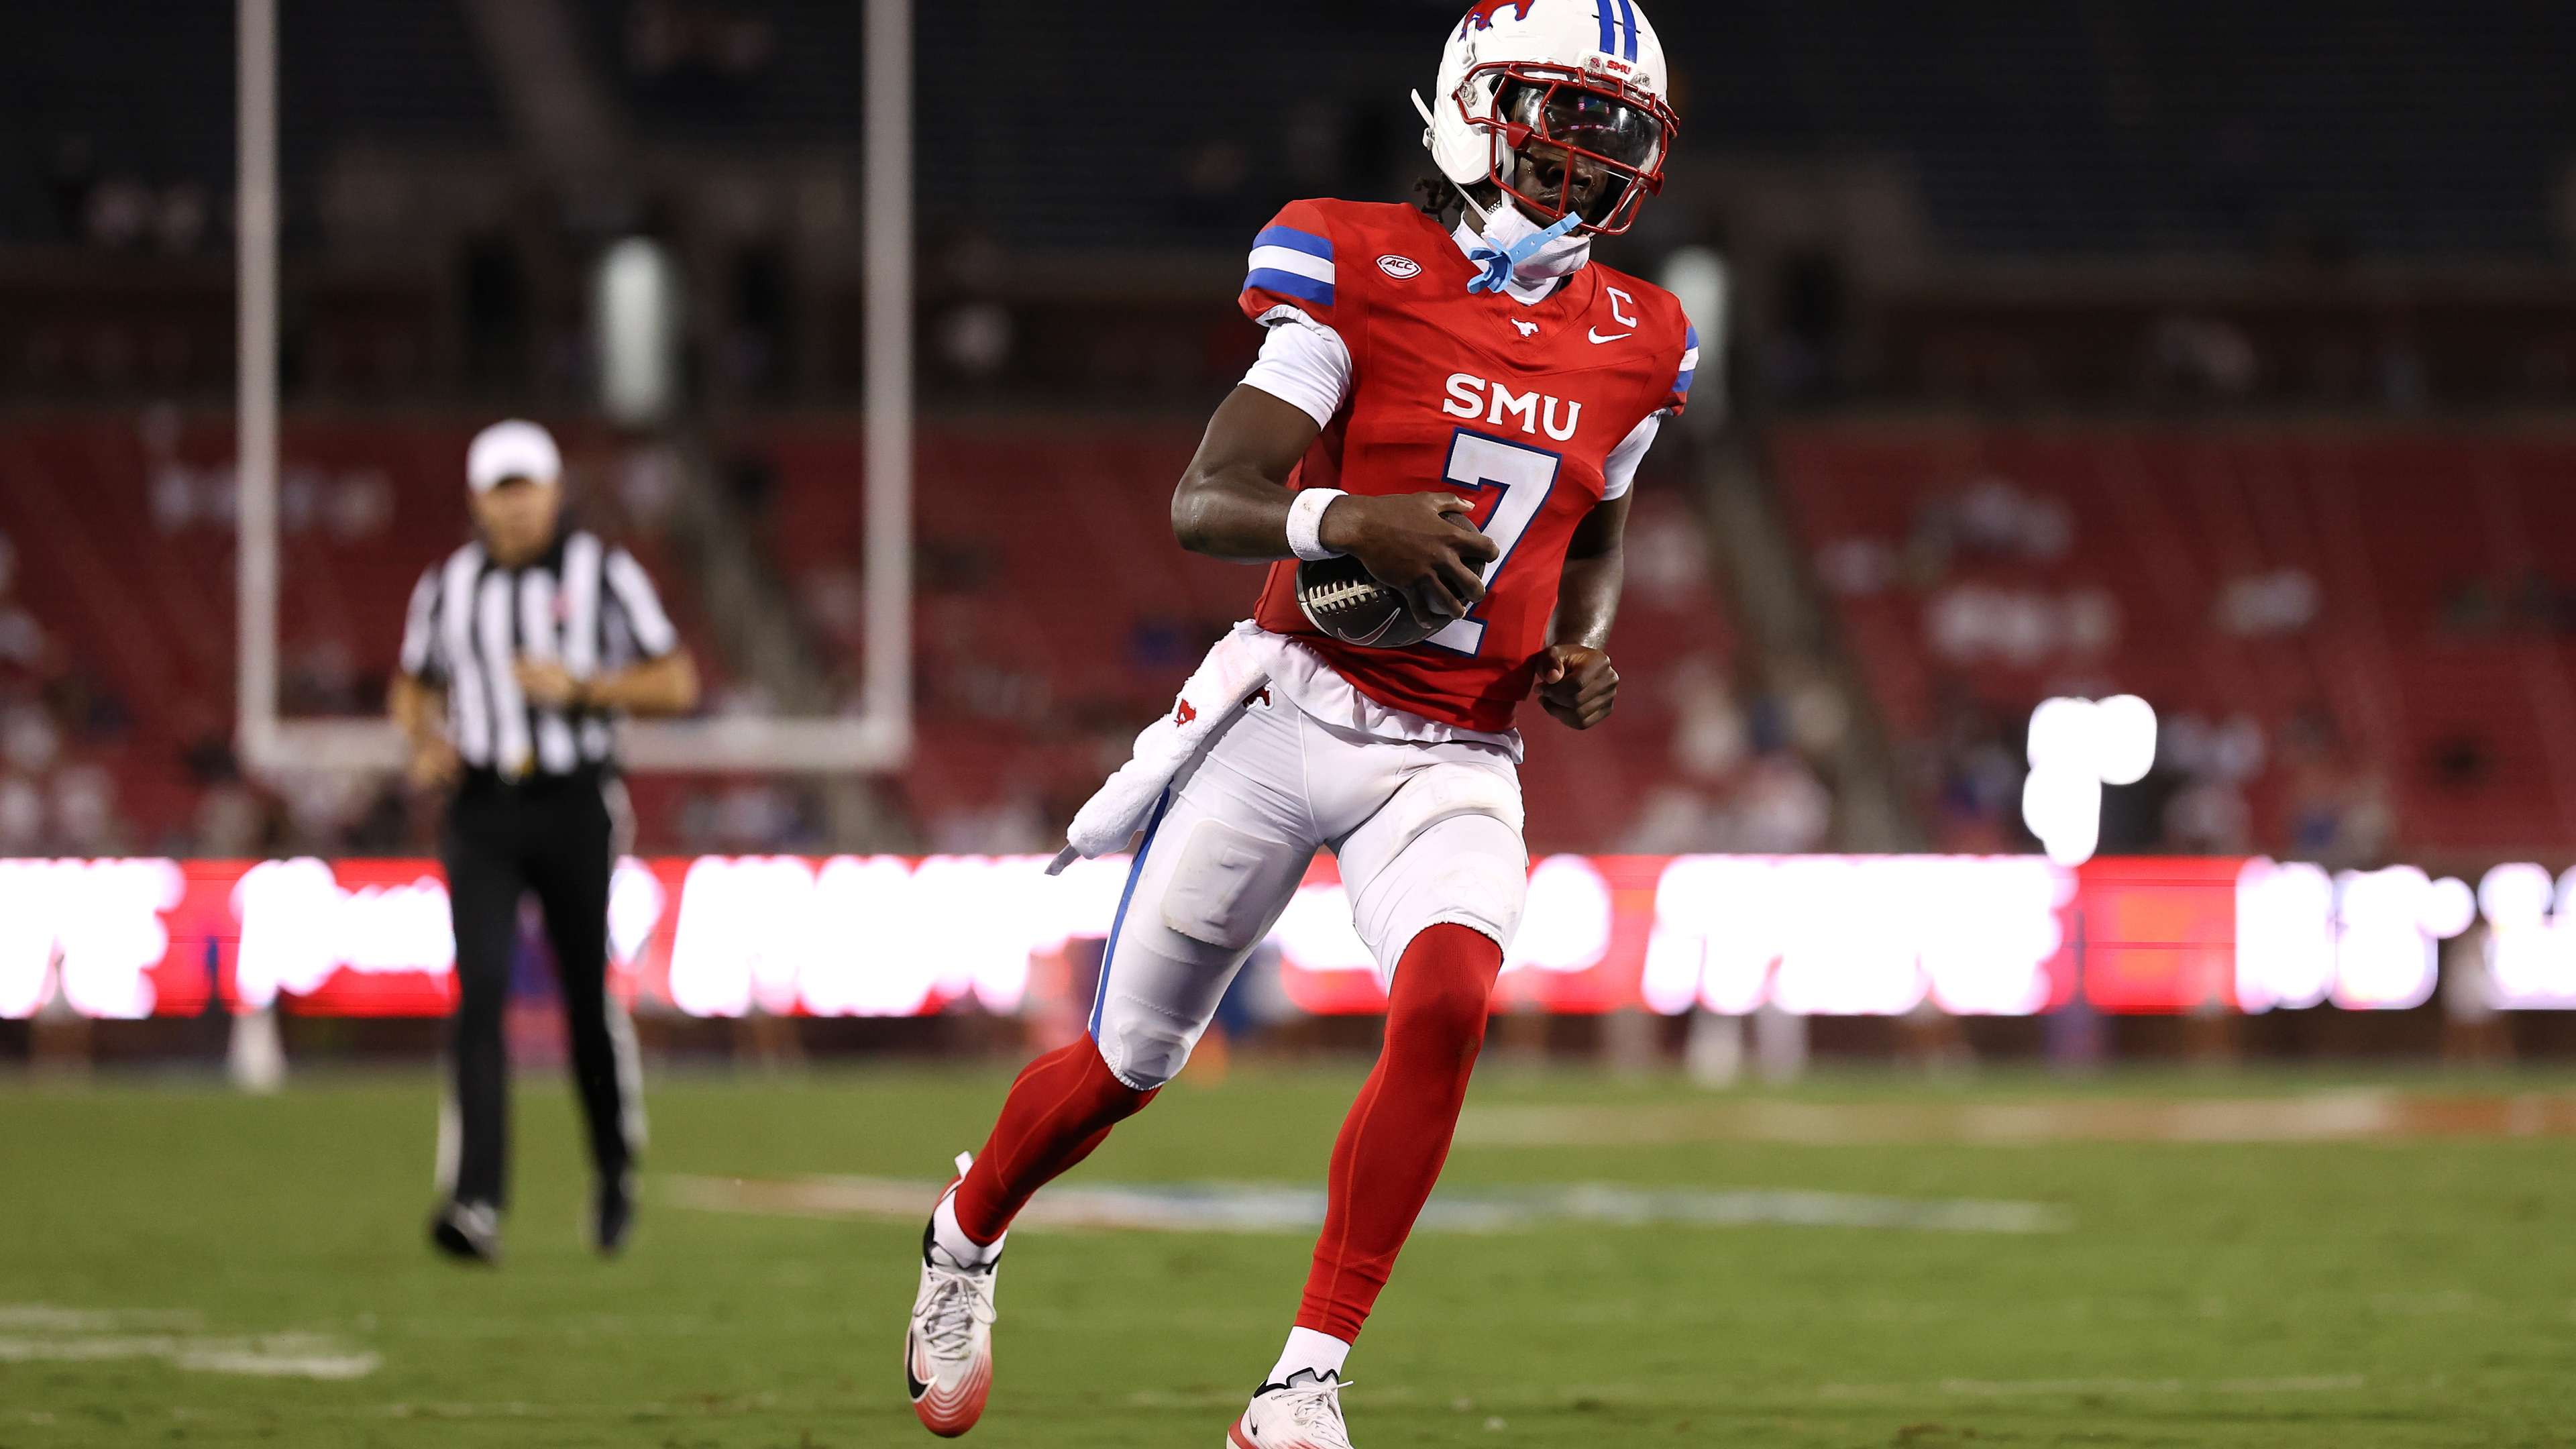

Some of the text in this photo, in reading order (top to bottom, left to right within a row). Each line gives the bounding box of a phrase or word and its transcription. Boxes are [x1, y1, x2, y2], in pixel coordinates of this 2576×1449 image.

[1385, 260, 1413, 270] ACC
[1606, 286, 1637, 328] C
[1442, 373, 1582, 441] SMU
[1417, 427, 1562, 657] 7
